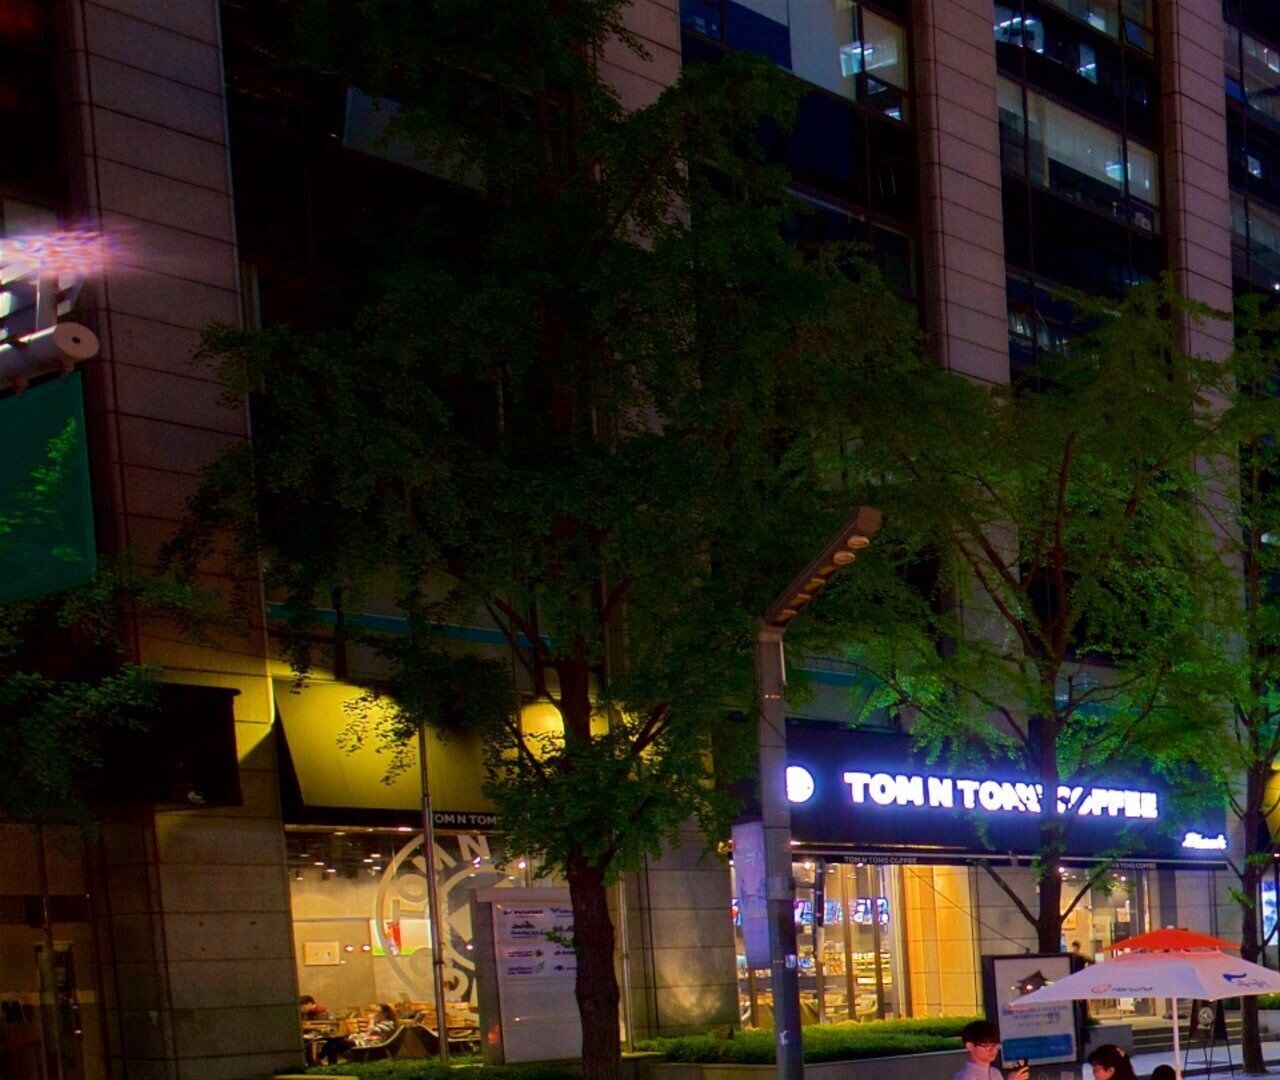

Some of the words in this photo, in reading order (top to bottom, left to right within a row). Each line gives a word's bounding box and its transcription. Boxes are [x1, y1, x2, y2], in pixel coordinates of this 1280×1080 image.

[843, 772, 924, 806] TOM
[927, 776, 953, 808] N
[431, 813, 456, 825] OM
[456, 814, 467, 825] N
[467, 814, 498, 826] TOM
